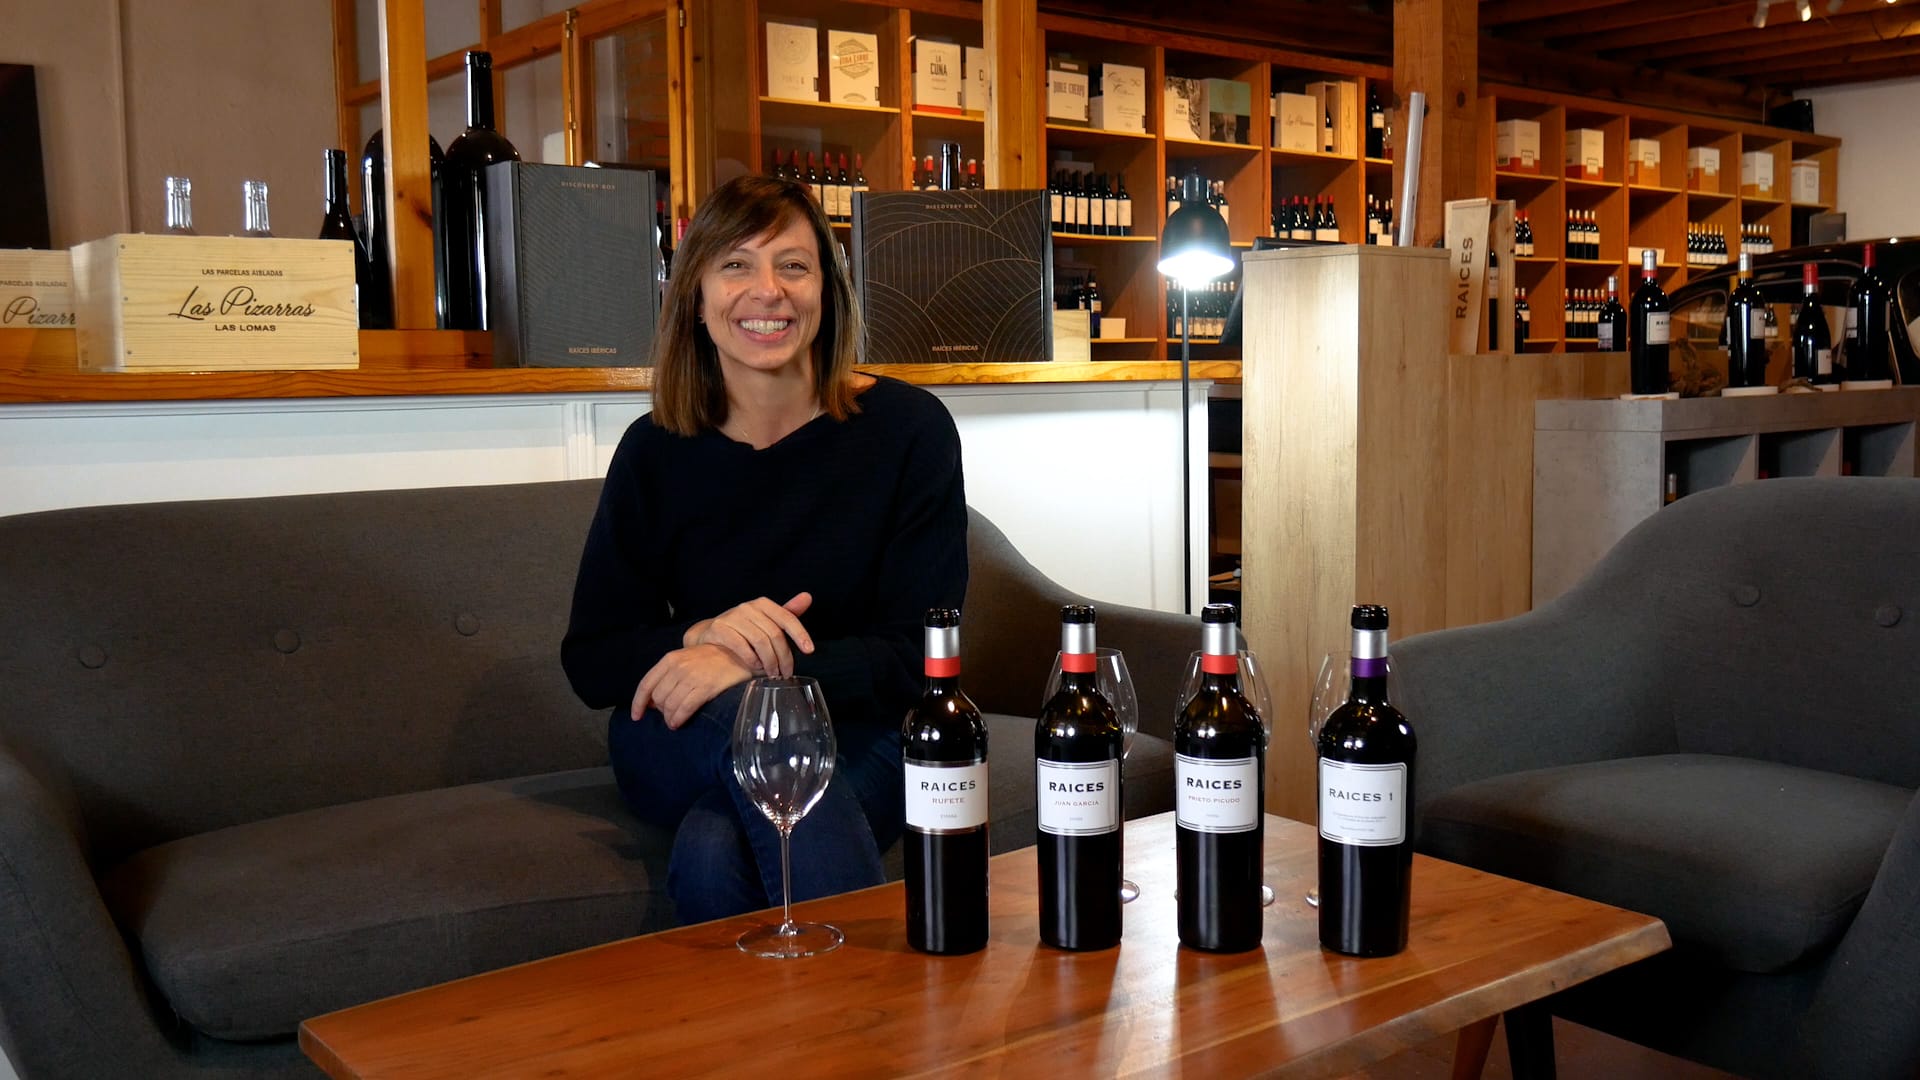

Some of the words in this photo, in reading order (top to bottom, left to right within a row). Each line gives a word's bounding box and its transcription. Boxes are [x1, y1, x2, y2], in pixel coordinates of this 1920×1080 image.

[930, 62, 948, 76] CUNA
[201, 268, 215, 276] LAS
[216, 269, 250, 277] PARCELAS
[251, 269, 283, 277] AISLADAS
[1455, 237, 1473, 319] RAICES
[168, 285, 215, 321] Las
[220, 285, 316, 317] Pizarras
[215, 324, 236, 332] LAS
[239, 324, 277, 332] LOMAS
[920, 780, 976, 792] RAICES
[1049, 781, 1105, 793] RAICES
[1186, 777, 1242, 790] RAICES
[1187, 795, 1211, 803] PRIETO
[1329, 787, 1382, 802] RAICES
[1389, 792, 1394, 801] 1
